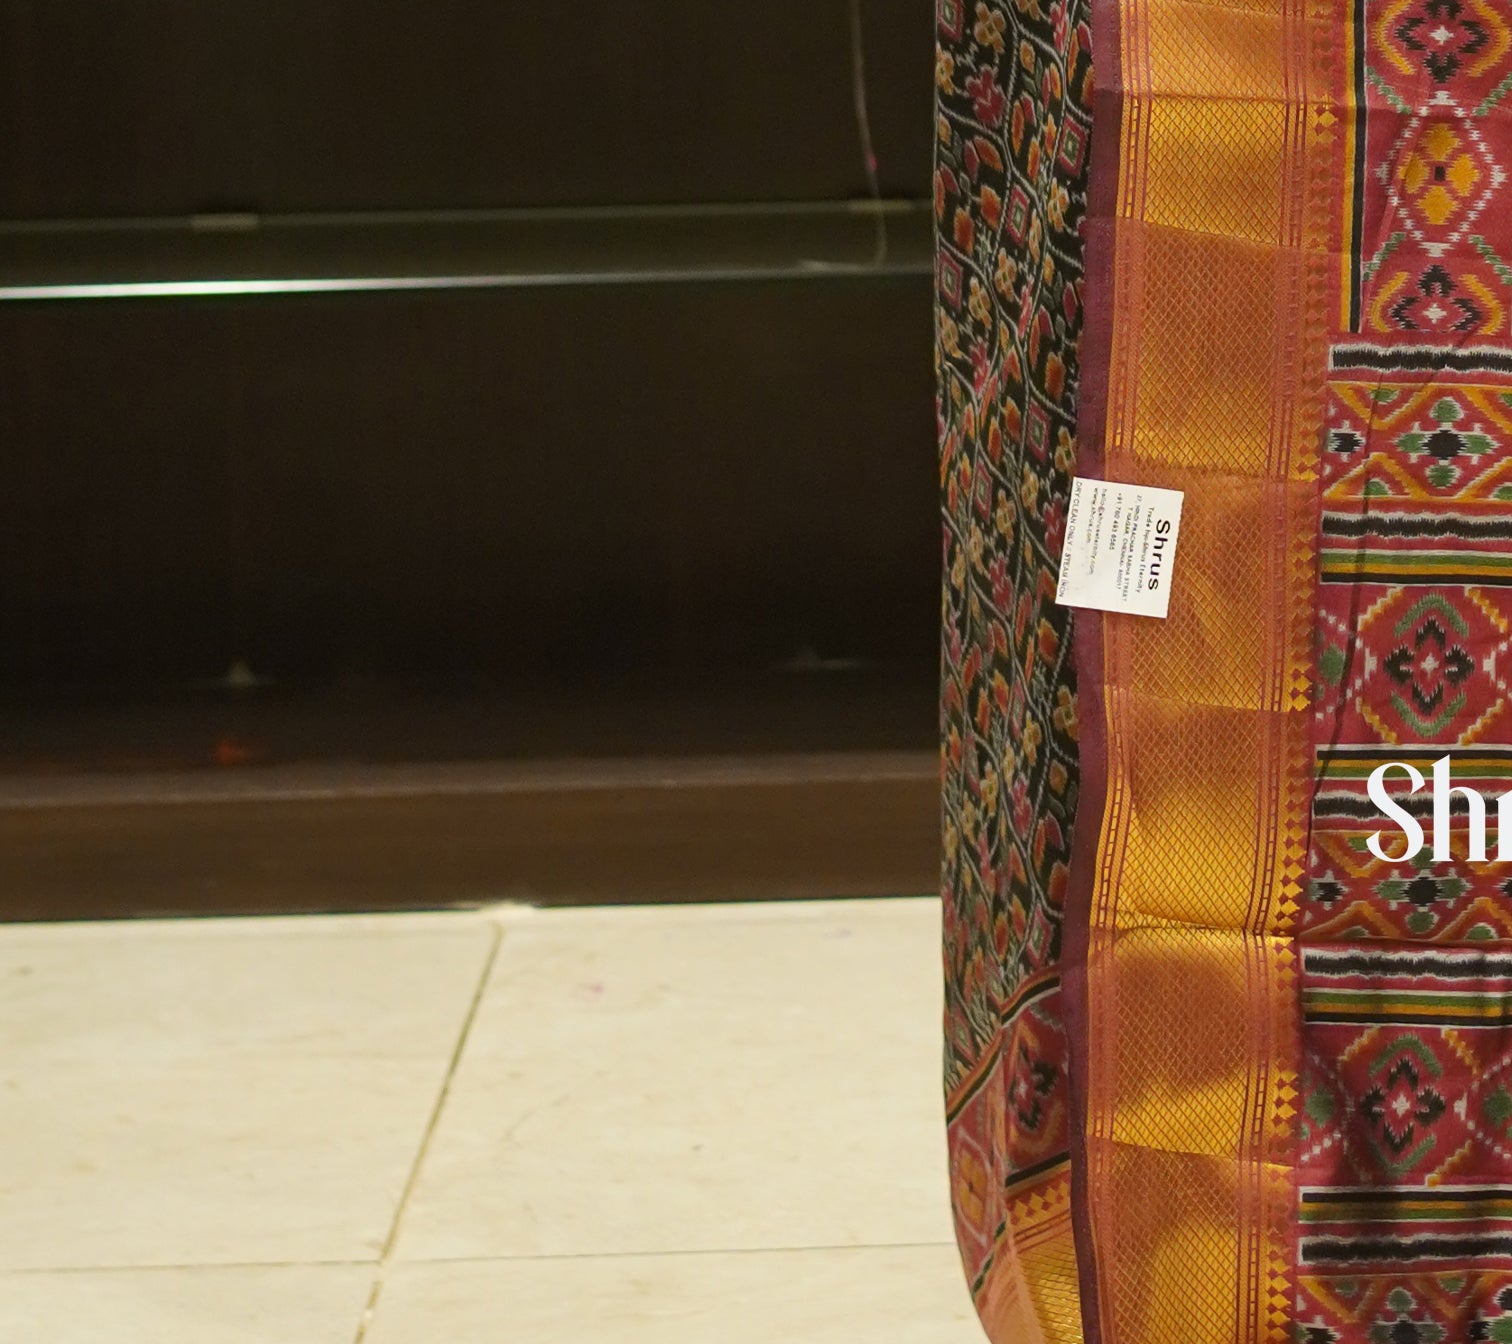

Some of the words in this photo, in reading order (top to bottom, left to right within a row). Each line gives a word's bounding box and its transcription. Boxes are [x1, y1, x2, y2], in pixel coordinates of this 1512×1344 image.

[1074, 481, 1082, 496] DRY
[1070, 498, 1079, 523] CLEAN
[1066, 525, 1075, 545] ONLY
[1062, 552, 1071, 577] STEAM
[1147, 518, 1171, 591] Shrus
[1135, 564, 1146, 592] Eternity
